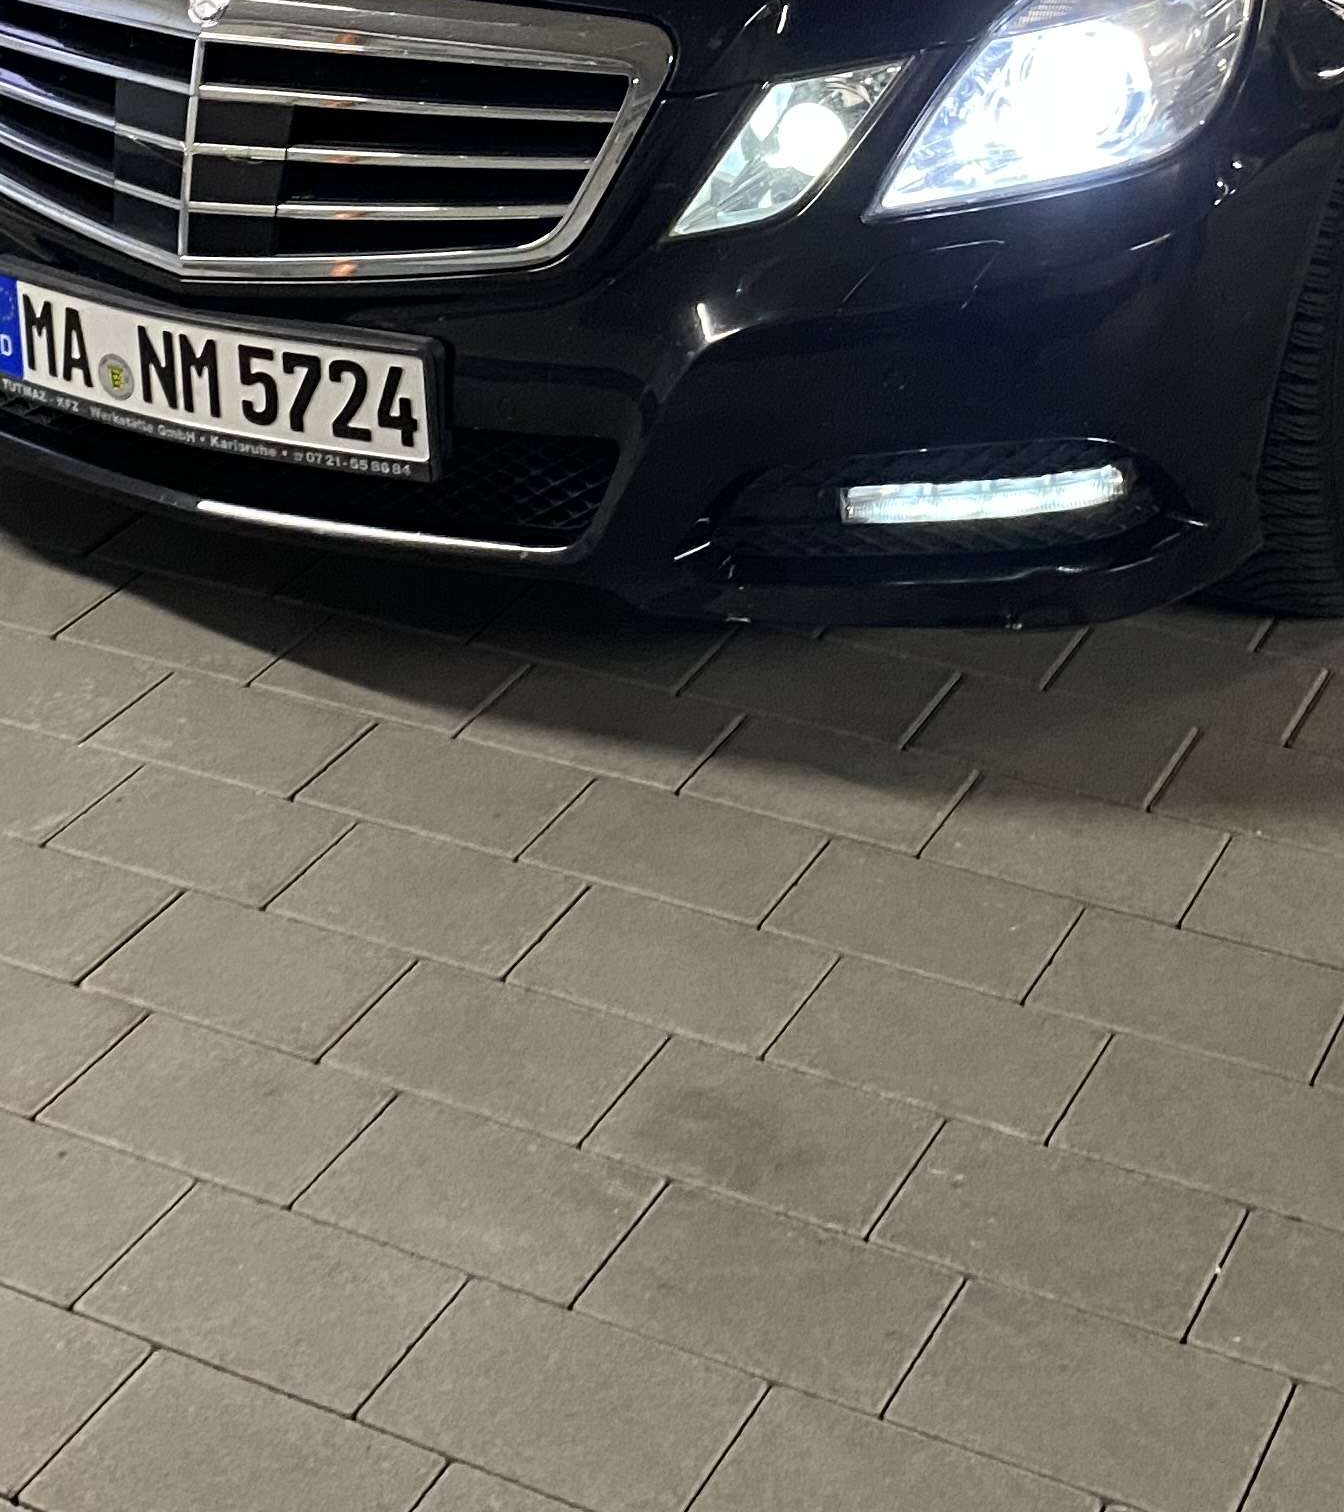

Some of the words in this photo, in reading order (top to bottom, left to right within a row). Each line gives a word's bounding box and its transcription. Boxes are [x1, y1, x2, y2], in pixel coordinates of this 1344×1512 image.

[0, 333, 13, 357] D
[22, 293, 94, 388] MA
[137, 324, 222, 418] NM
[237, 343, 420, 448] 5724
[157, 424, 197, 444] GmbH
[209, 435, 277, 458] Karlsruhe
